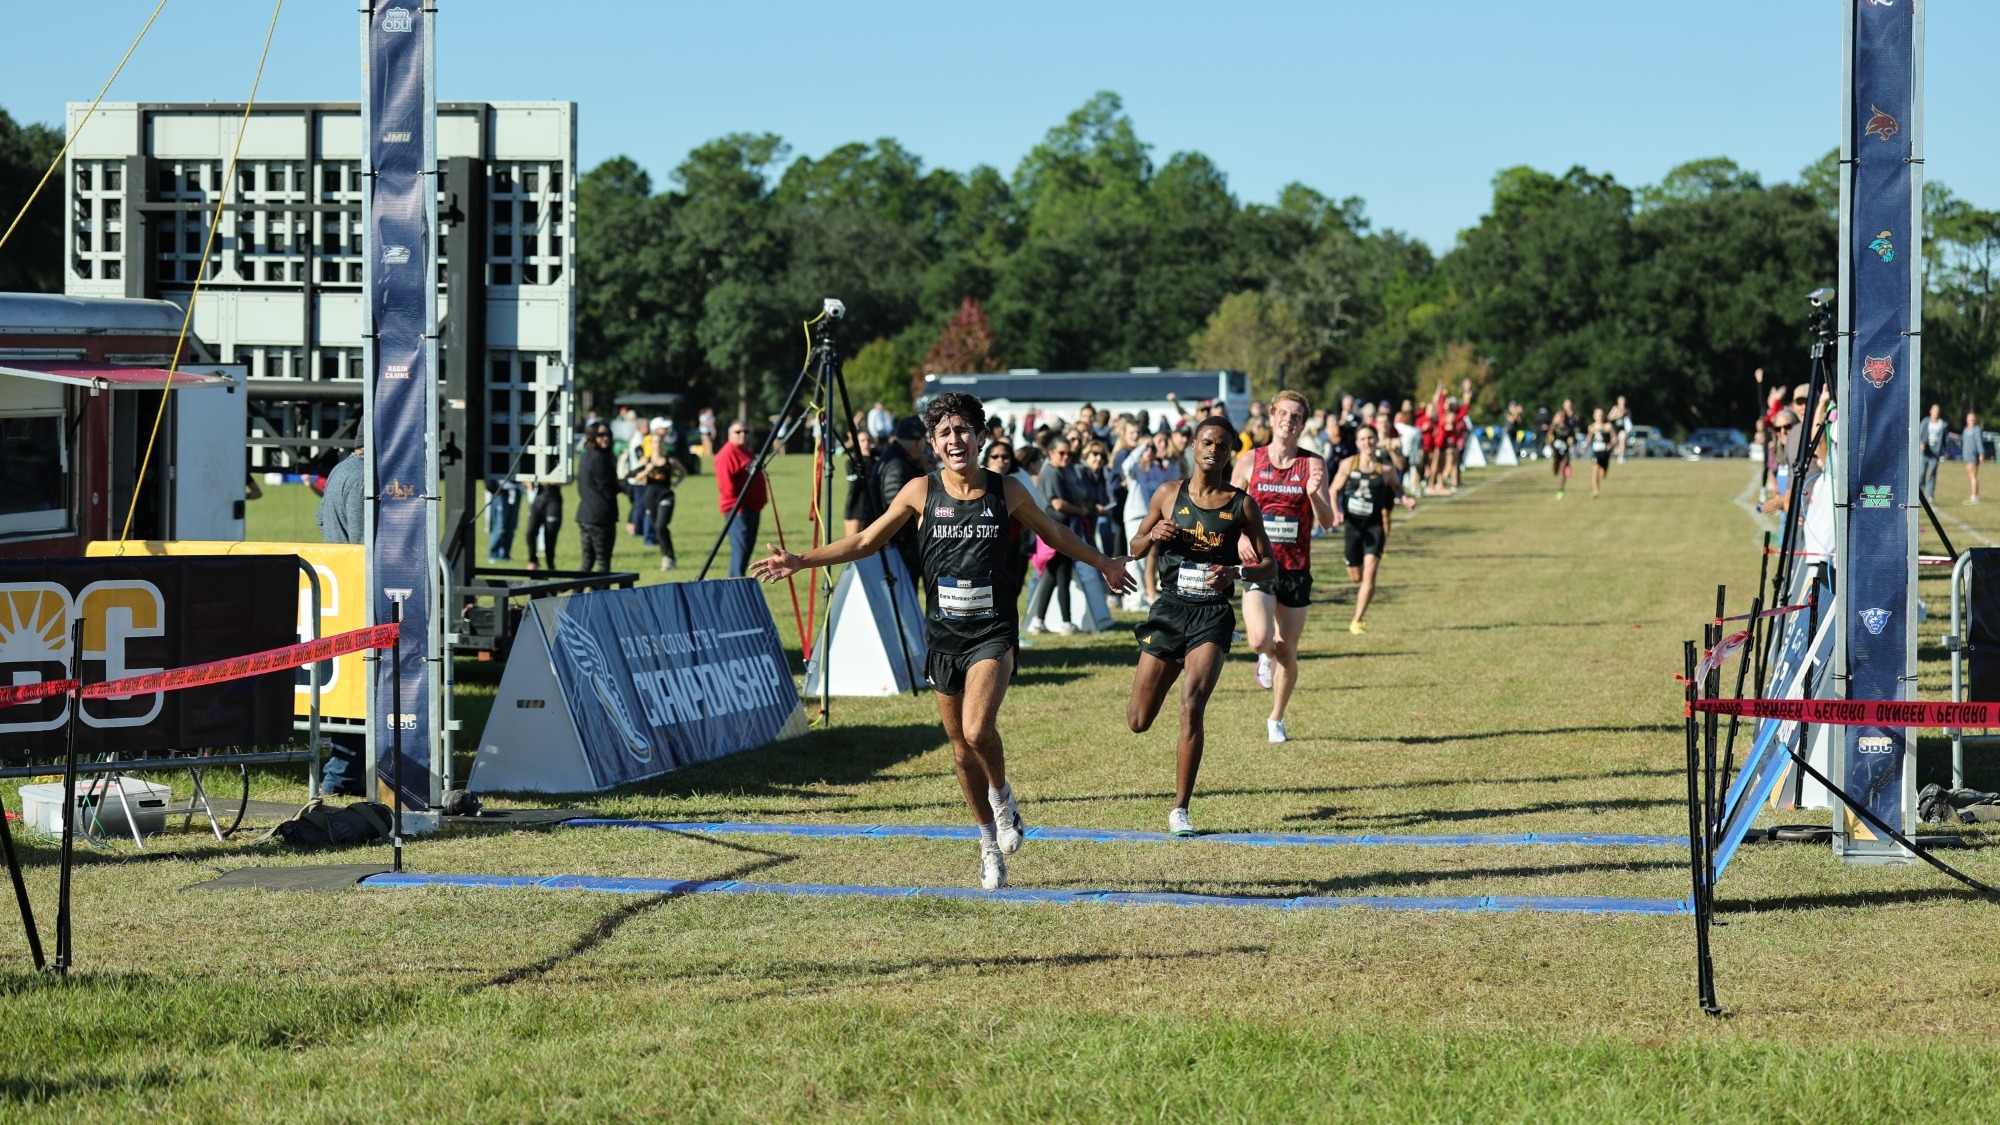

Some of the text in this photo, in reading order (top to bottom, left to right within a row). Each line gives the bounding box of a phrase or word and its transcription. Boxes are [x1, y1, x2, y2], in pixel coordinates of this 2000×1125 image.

[382, 19, 411, 31] ODU
[382, 132, 411, 143] JMU
[1257, 483, 1303, 494] LOUISIANA
[935, 507, 954, 517] SBC
[933, 525, 999, 538] ARKANSAS STATE
[620, 628, 720, 658] CROSS COUNTRY
[632, 654, 780, 727] CHAMPIONSHIP
[1859, 737, 1893, 753] SBC
